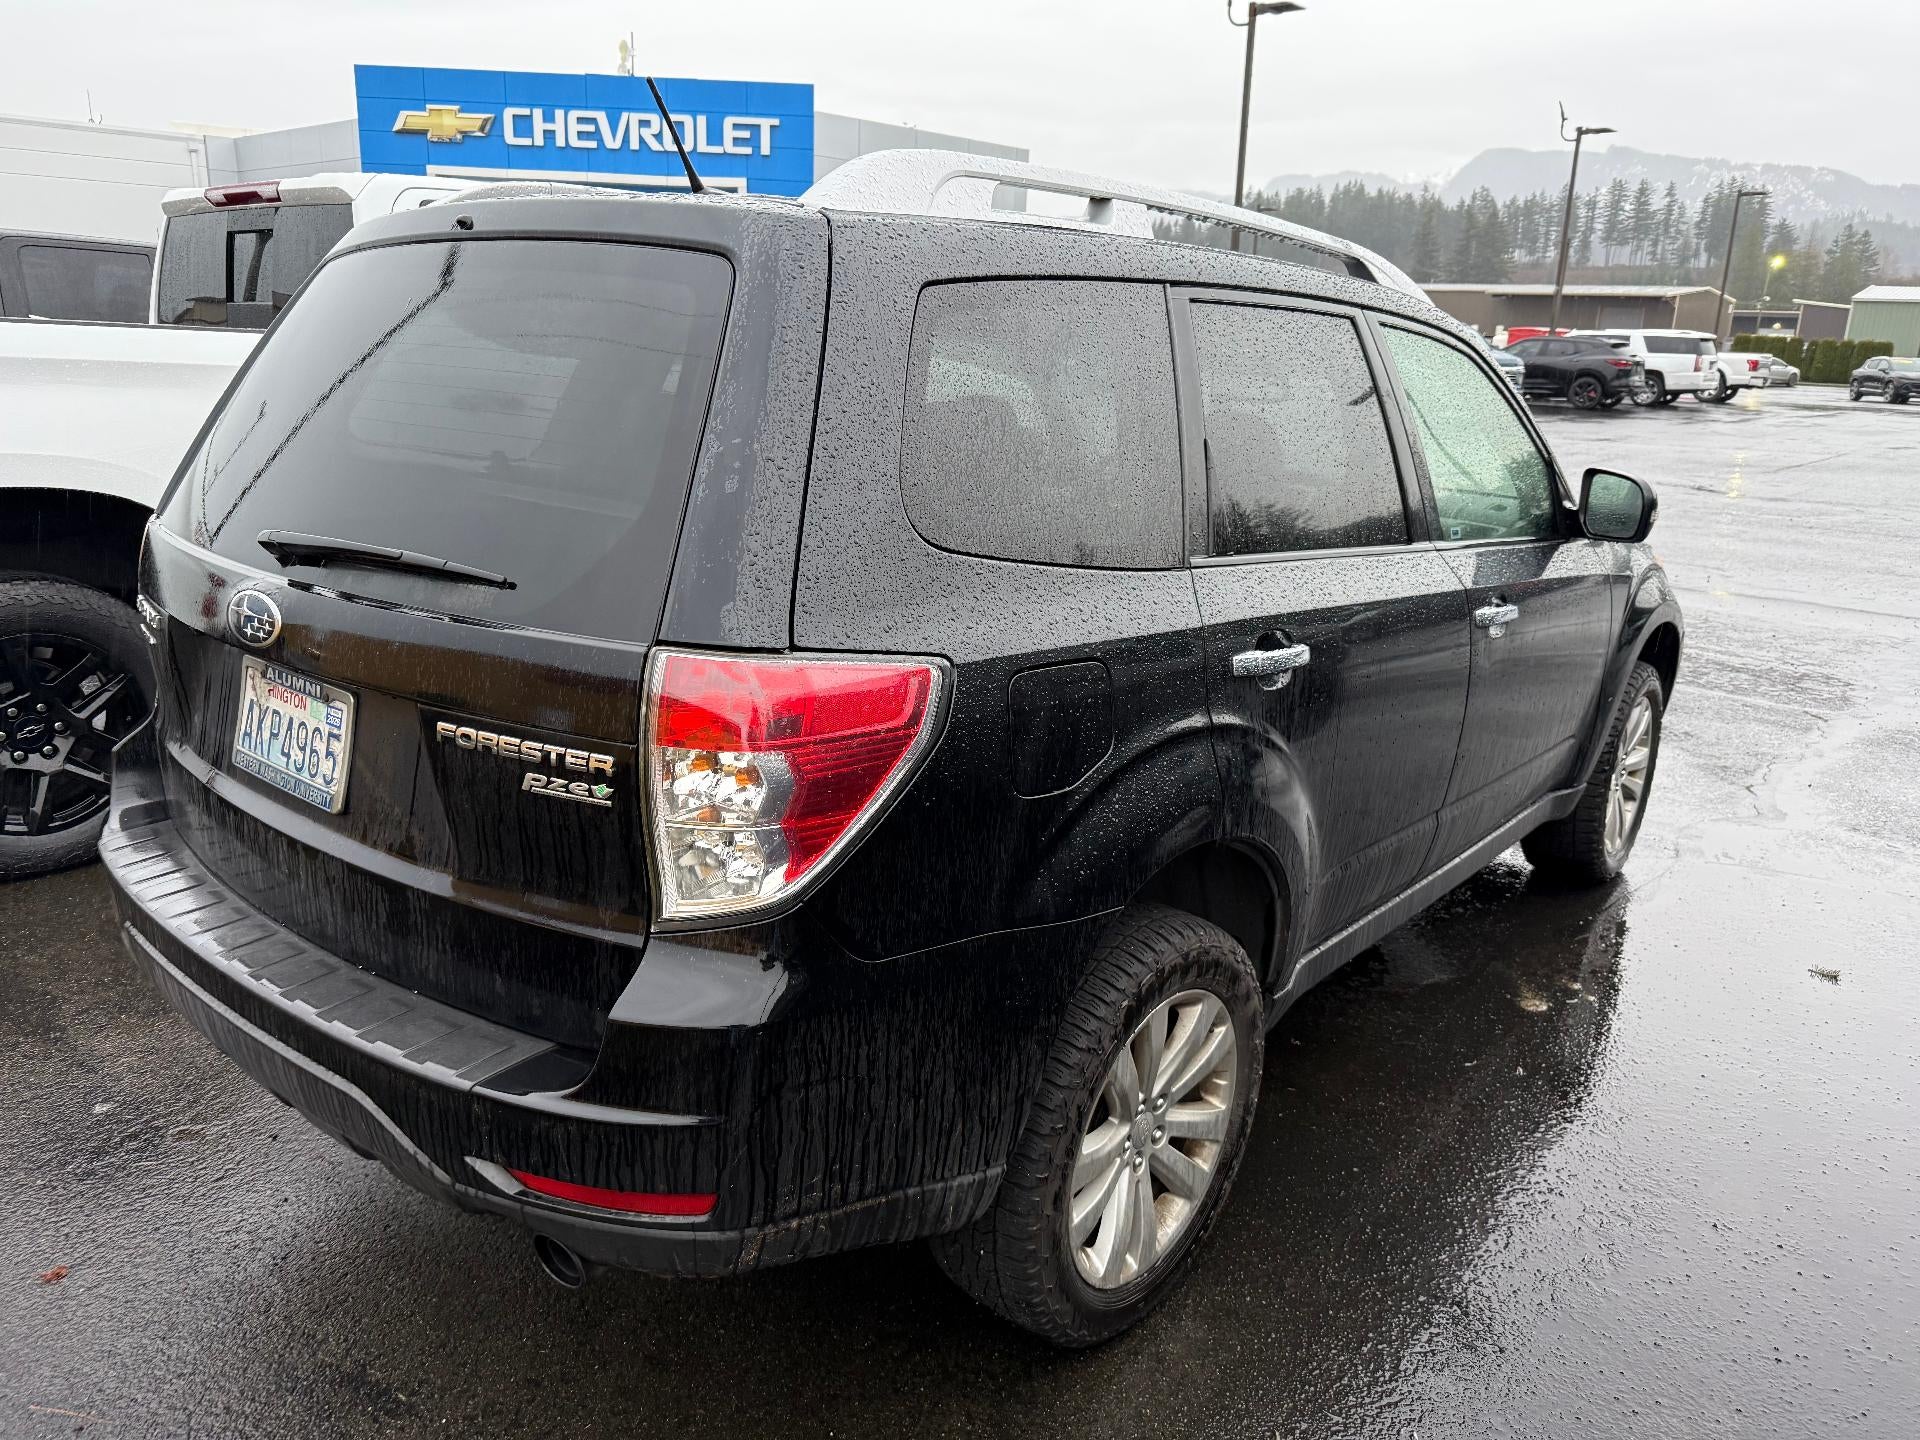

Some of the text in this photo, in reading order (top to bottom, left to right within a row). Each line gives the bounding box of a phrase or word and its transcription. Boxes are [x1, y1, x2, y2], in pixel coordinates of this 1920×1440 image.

[502, 106, 780, 156] CHEVROLET
[266, 667, 321, 698] ALUMNI
[436, 721, 617, 777] FORESTER
[294, 780, 332, 809] UNIVERSITY
